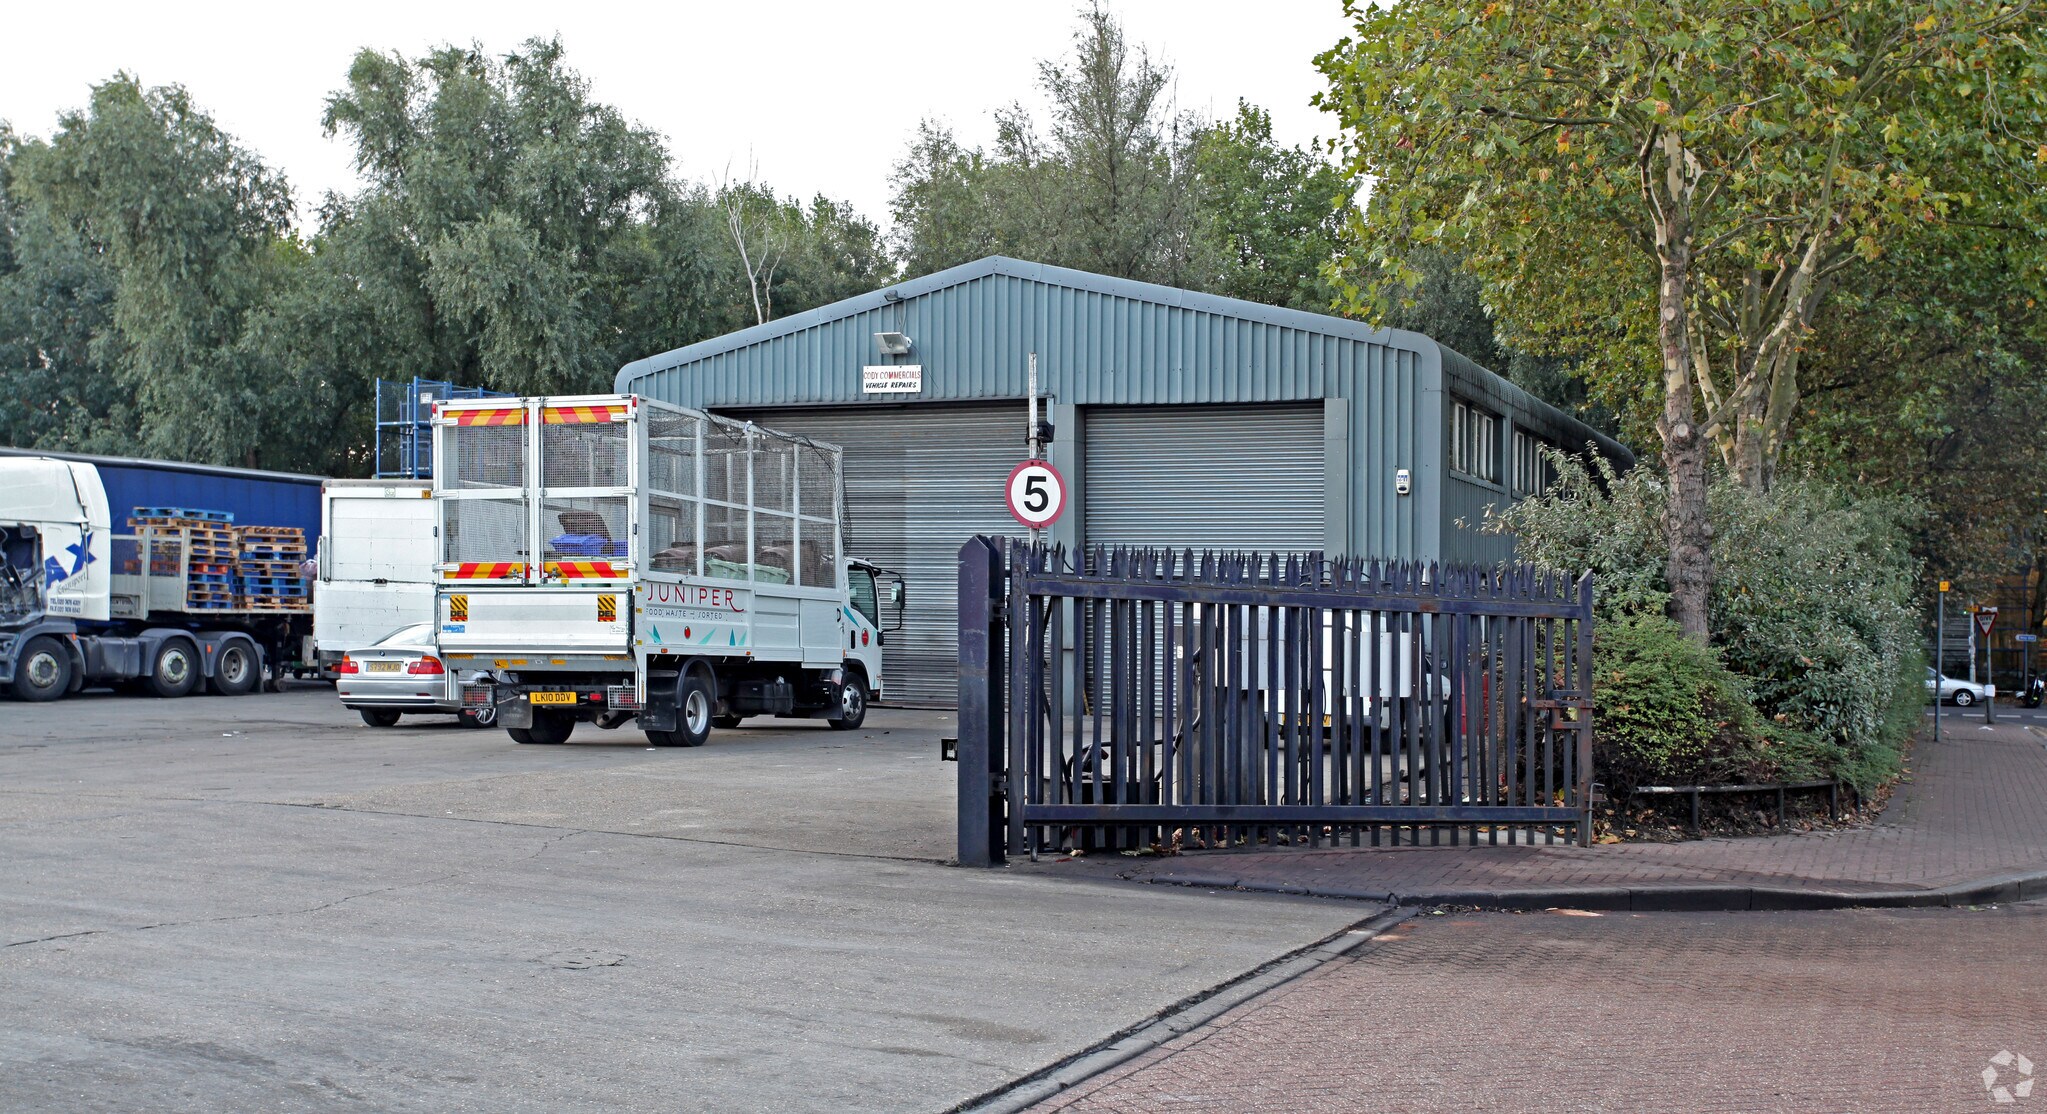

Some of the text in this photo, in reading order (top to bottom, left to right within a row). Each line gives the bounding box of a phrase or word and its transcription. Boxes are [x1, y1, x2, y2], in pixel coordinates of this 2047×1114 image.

[880, 371, 921, 379] COMMERCIALS
[1023, 475, 1049, 513] 5
[647, 583, 745, 612] JUNIPER
[665, 609, 687, 618] WASTE
[697, 612, 723, 620] SORTED
[535, 693, 571, 702] LK10 DDV
